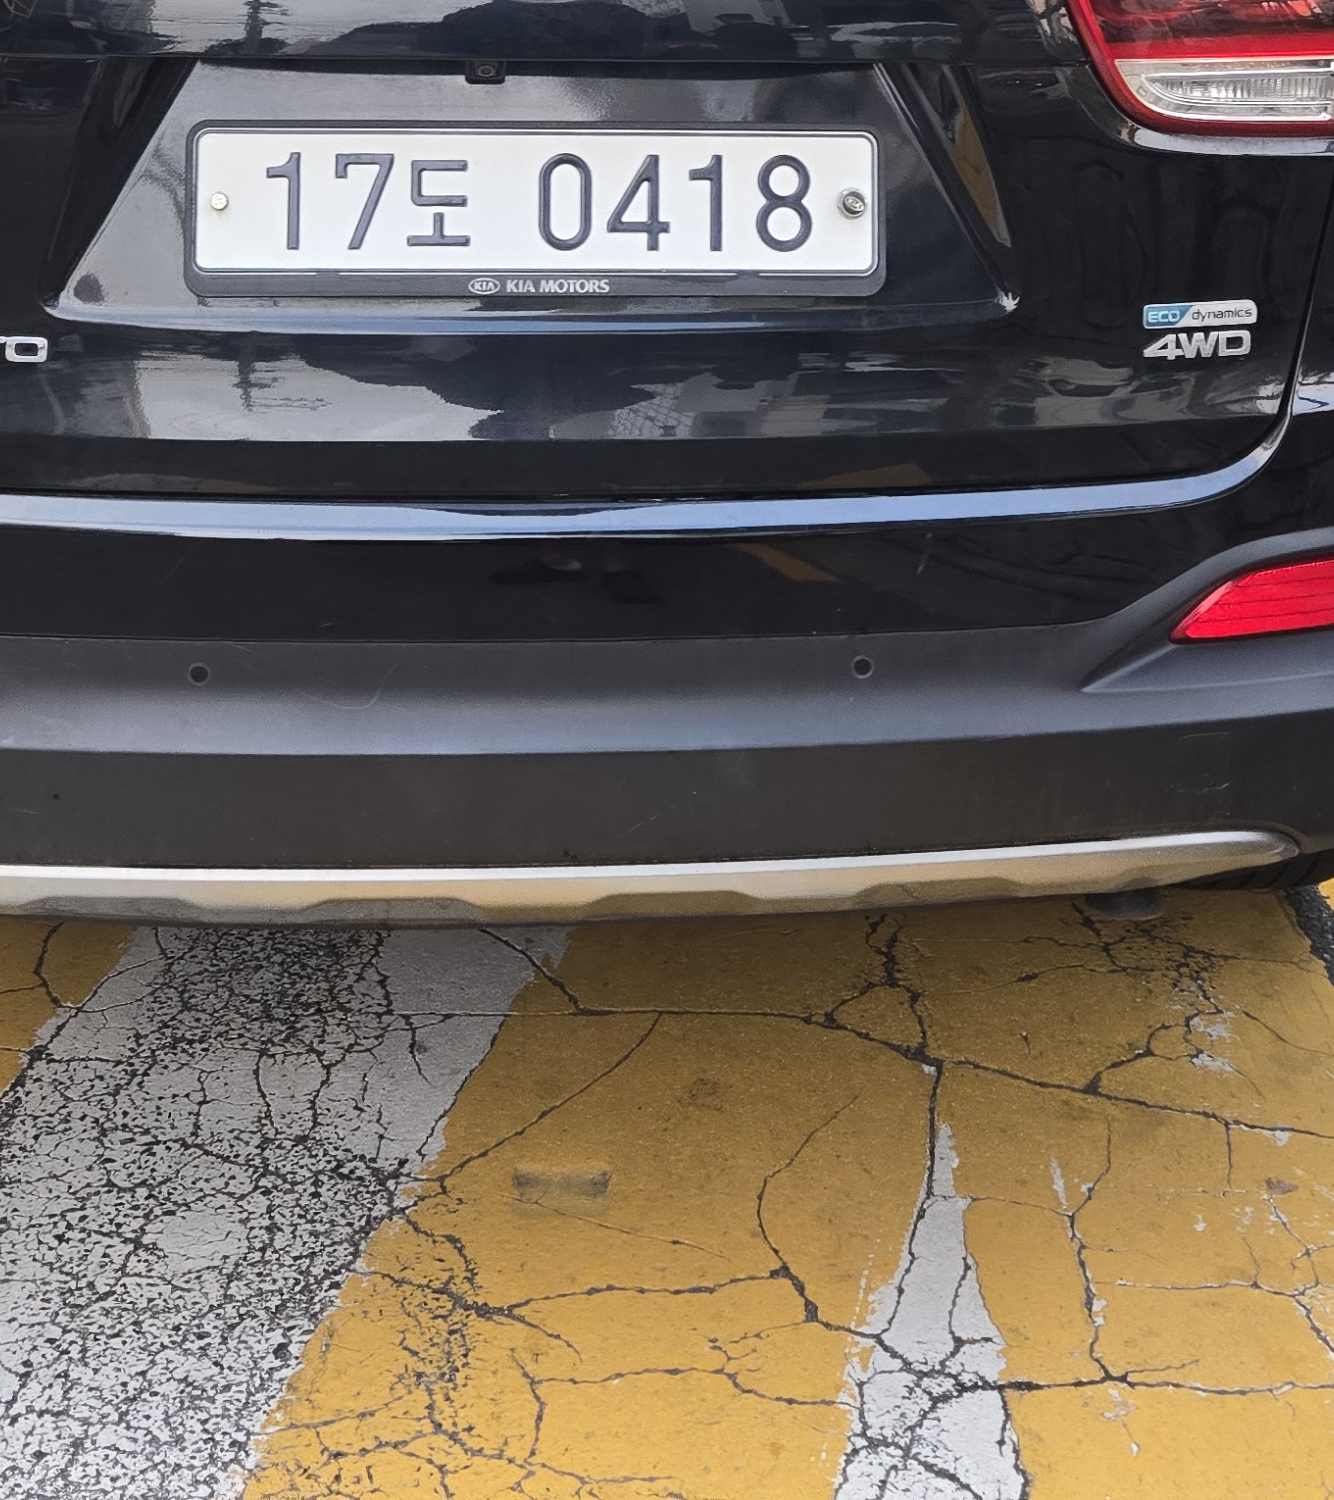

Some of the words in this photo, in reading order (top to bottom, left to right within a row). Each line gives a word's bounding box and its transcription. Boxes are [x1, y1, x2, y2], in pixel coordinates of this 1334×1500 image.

[266, 151, 471, 251] 17도
[538, 152, 813, 253] 0418
[505, 278, 536, 293] KIA
[539, 278, 610, 294] MOTORS
[1147, 309, 1181, 323] ECO
[1191, 306, 1252, 323] dynamics
[1142, 329, 1251, 361] 4WD
